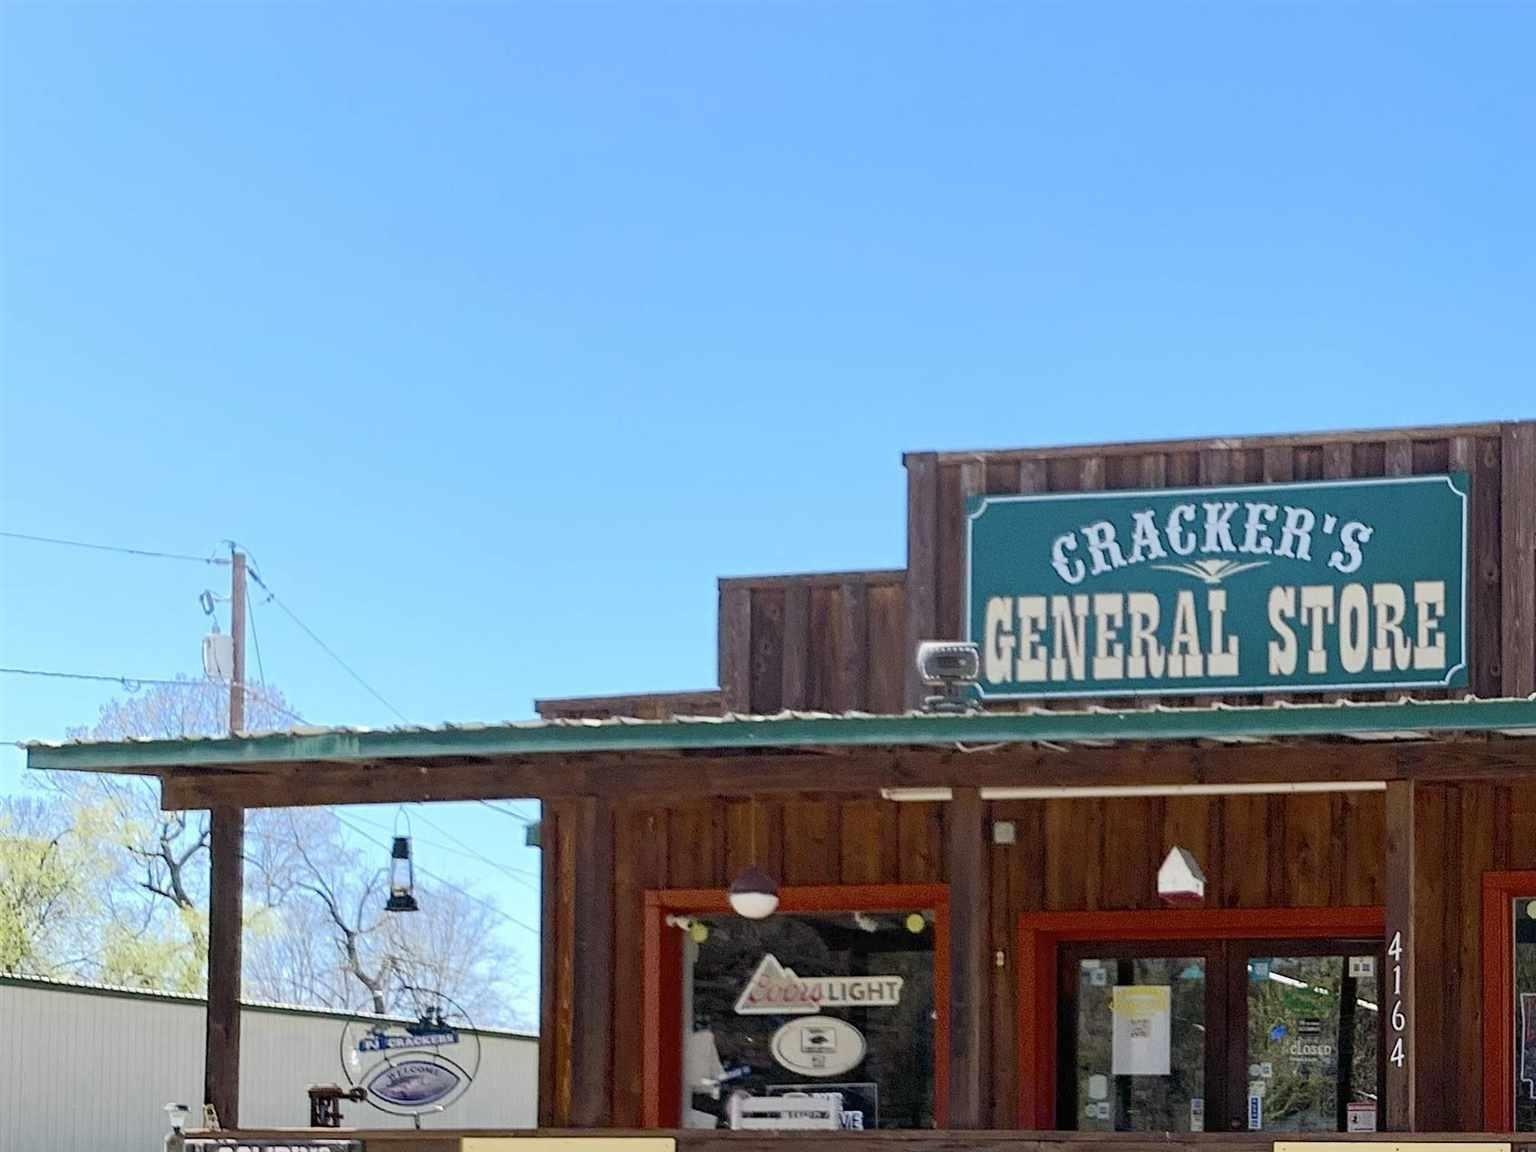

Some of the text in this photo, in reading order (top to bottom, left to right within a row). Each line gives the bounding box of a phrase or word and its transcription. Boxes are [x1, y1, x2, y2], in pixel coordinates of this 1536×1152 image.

[1051, 501, 1373, 584] CRACKER'S
[984, 580, 1446, 683] GENERAL STORE
[828, 981, 898, 1002] LIGHT
[1387, 930, 1406, 1068] 4164
